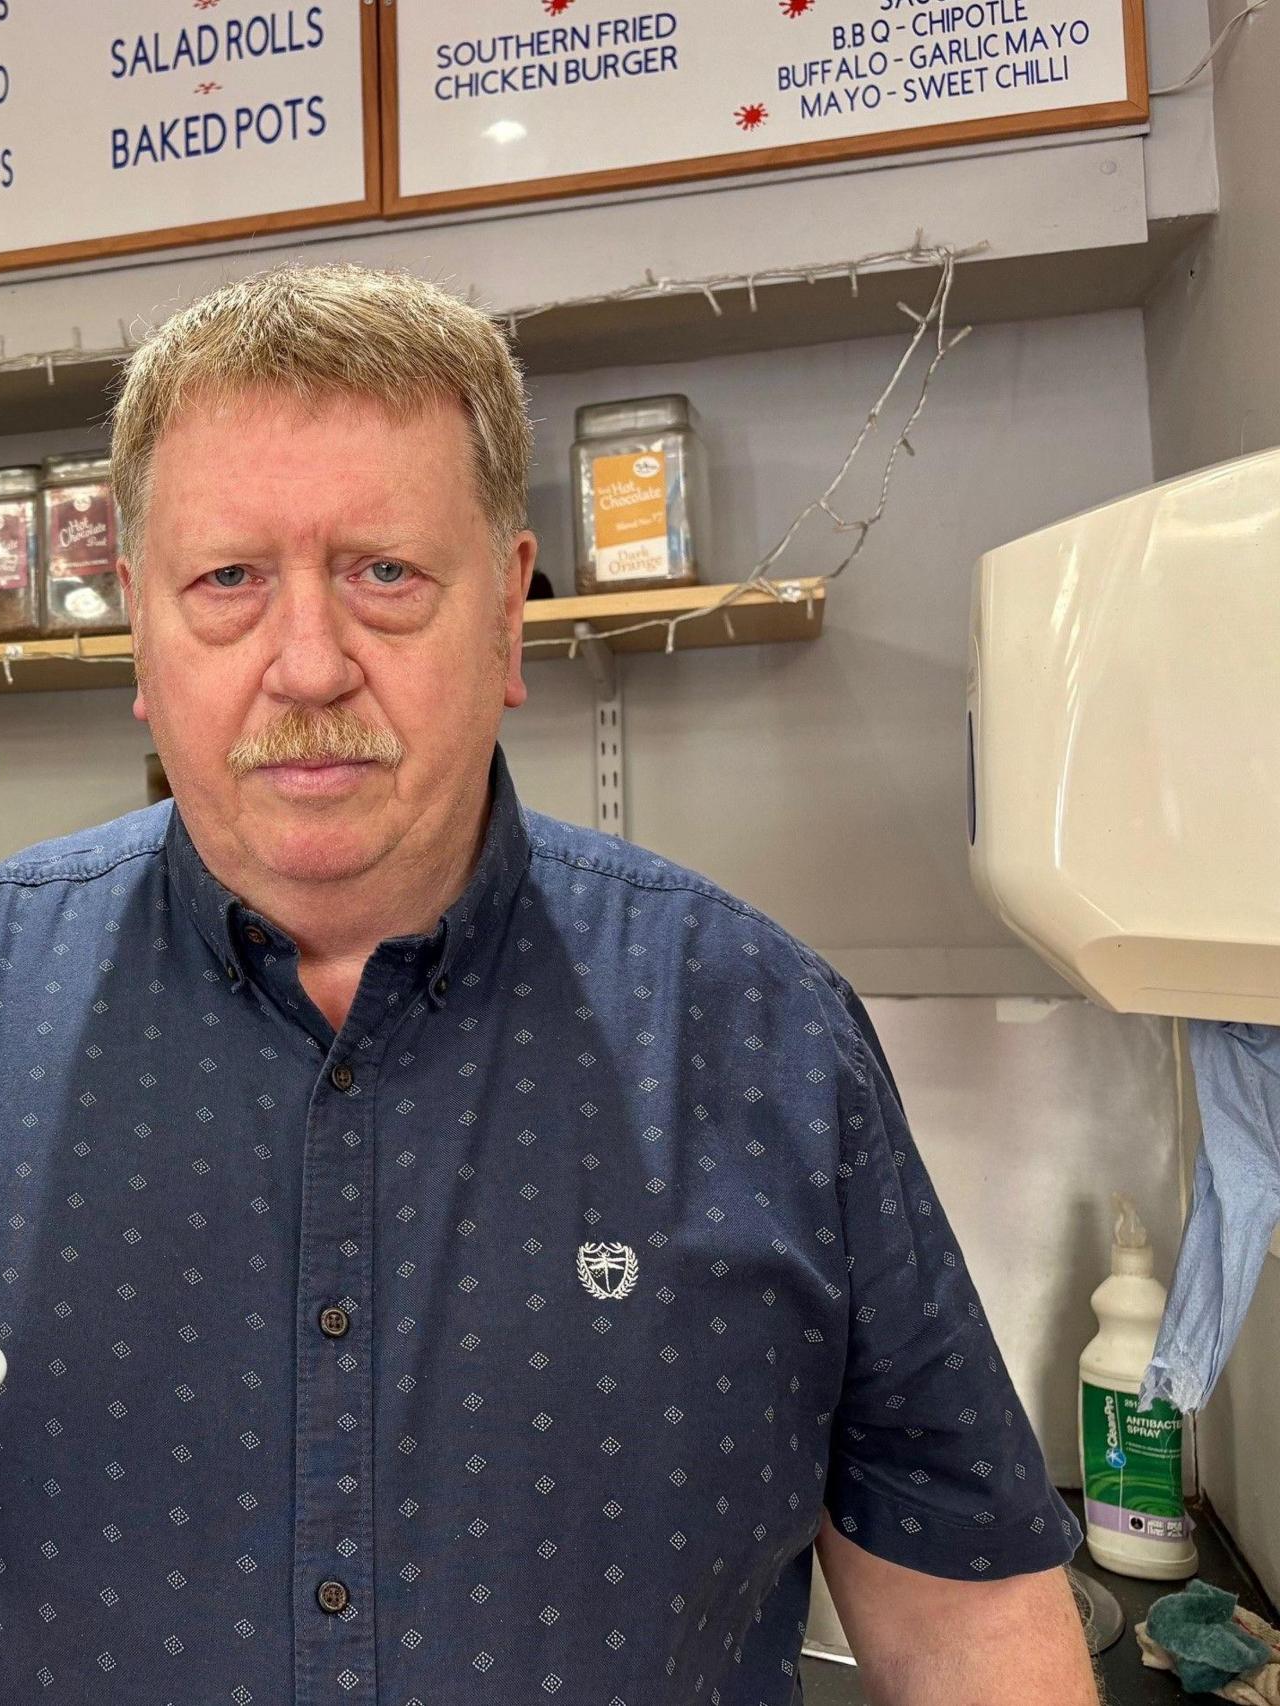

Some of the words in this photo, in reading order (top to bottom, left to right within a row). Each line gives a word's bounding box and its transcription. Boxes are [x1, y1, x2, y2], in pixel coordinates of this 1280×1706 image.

[111, 24, 218, 79] SALAD
[226, 6, 324, 62] ROLLS
[436, 25, 589, 70] SOUTHERN
[597, 12, 678, 45] FRIED
[912, 0, 1028, 37] CHIPOTLE
[434, 62, 559, 102] CHICKEN
[564, 45, 678, 85] BURGER
[778, 52, 887, 91] BUFFALO
[910, 34, 999, 70] GARLIC
[1006, 20, 1090, 55] MAYO
[801, 85, 881, 119] MAYO
[904, 67, 988, 103] SWEET
[995, 55, 1069, 89] CHILLI
[112, 113, 226, 169] BAKED
[236, 95, 327, 149] POTS
[1126, 1425, 1161, 1439] SPRAY
